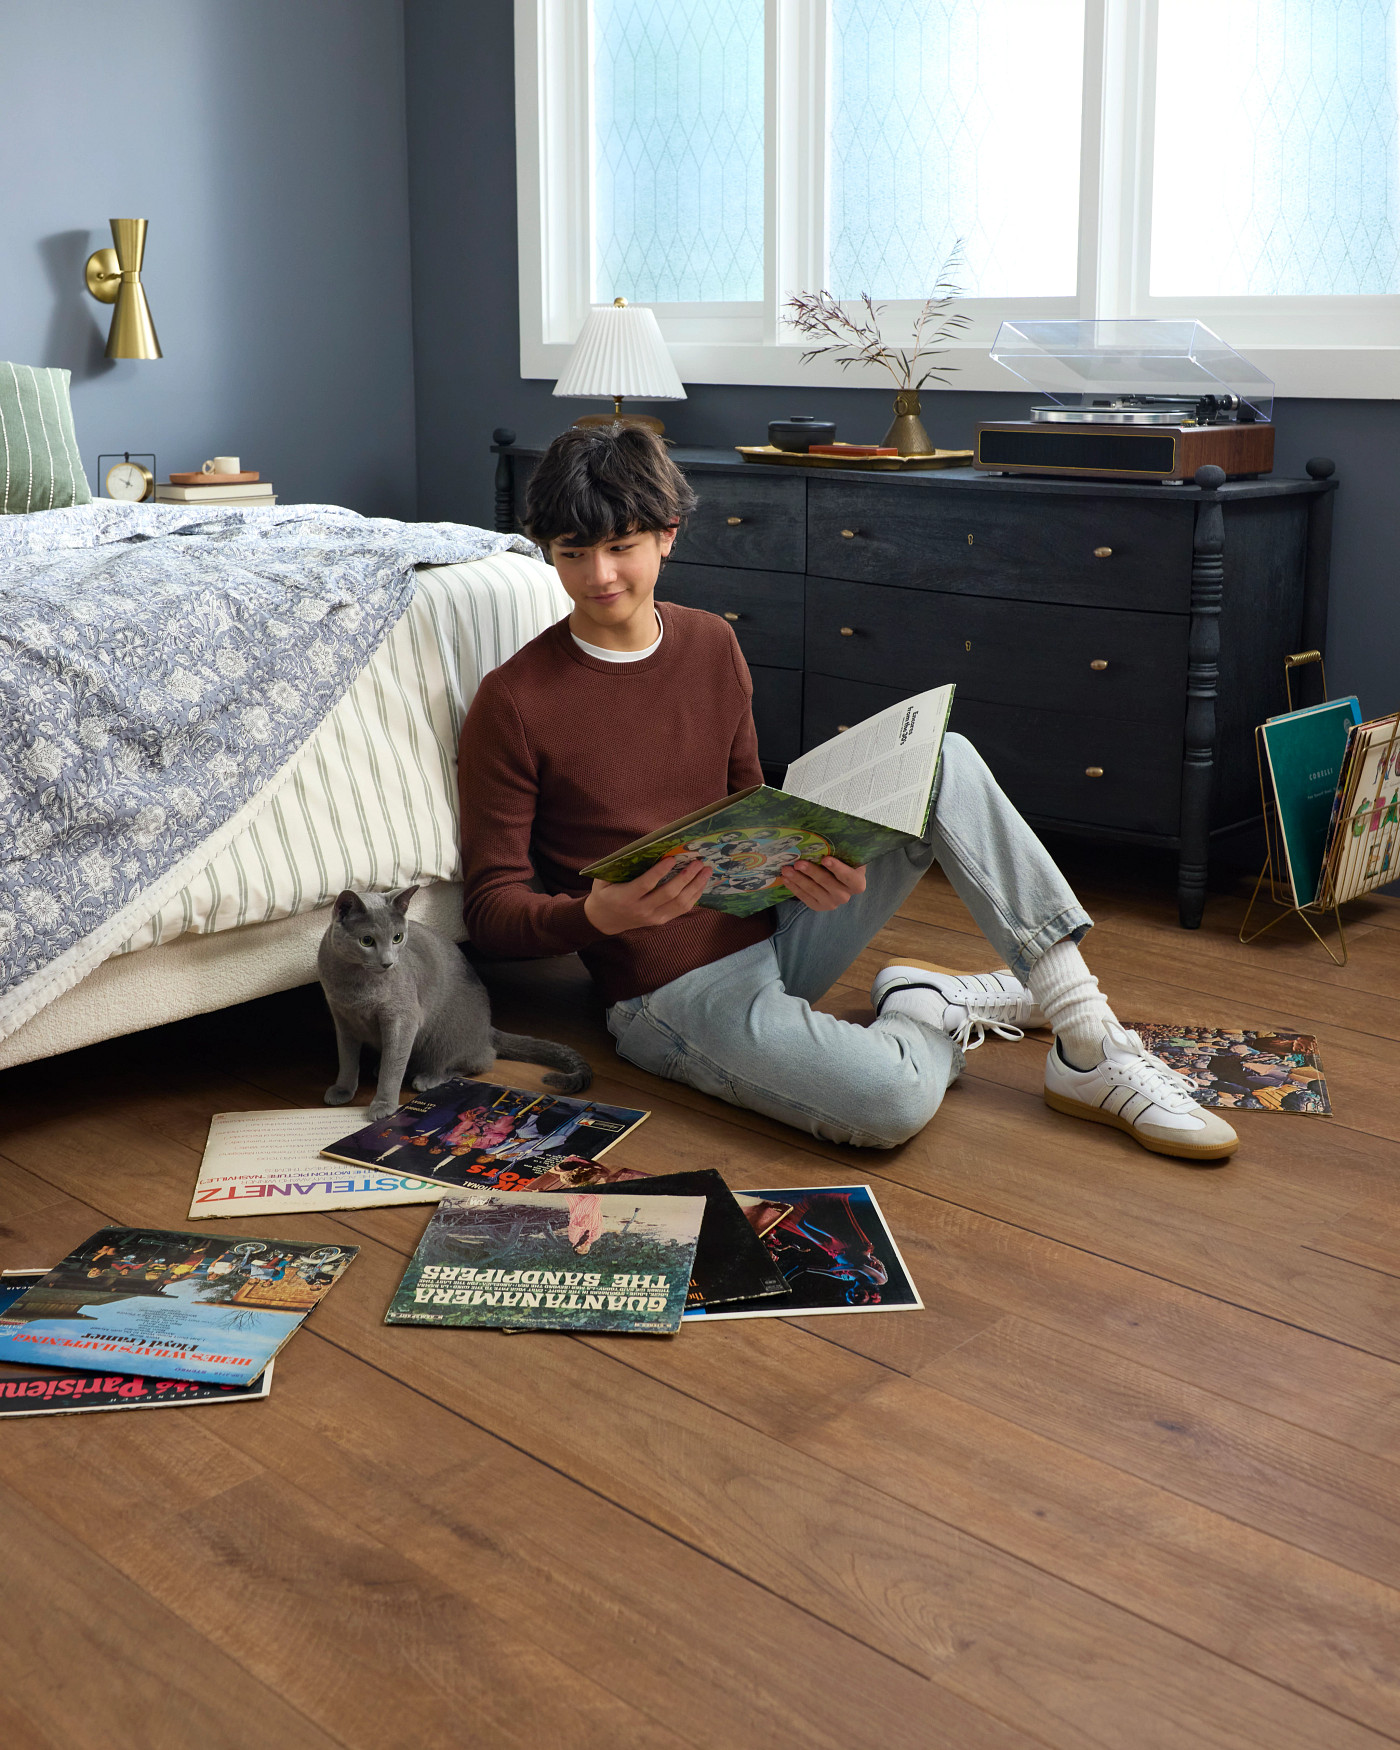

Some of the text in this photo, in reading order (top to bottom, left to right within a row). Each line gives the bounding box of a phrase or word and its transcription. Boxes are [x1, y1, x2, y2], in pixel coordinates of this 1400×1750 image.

[465, 1164, 536, 1187] POTS
[195, 1178, 446, 1204] OSTELANETZ
[421, 1266, 602, 1287] SANDPIPERS
[611, 1275, 670, 1289] THE
[414, 1288, 668, 1312] GUANTANAMERA
[12, 1333, 253, 1366] HERE'S WHAT'S HAPPENING!
[81, 1333, 200, 1353] Floyd Cramer
[0, 1376, 149, 1401] Parisien
[109, 1391, 211, 1402] OFFENBACH
